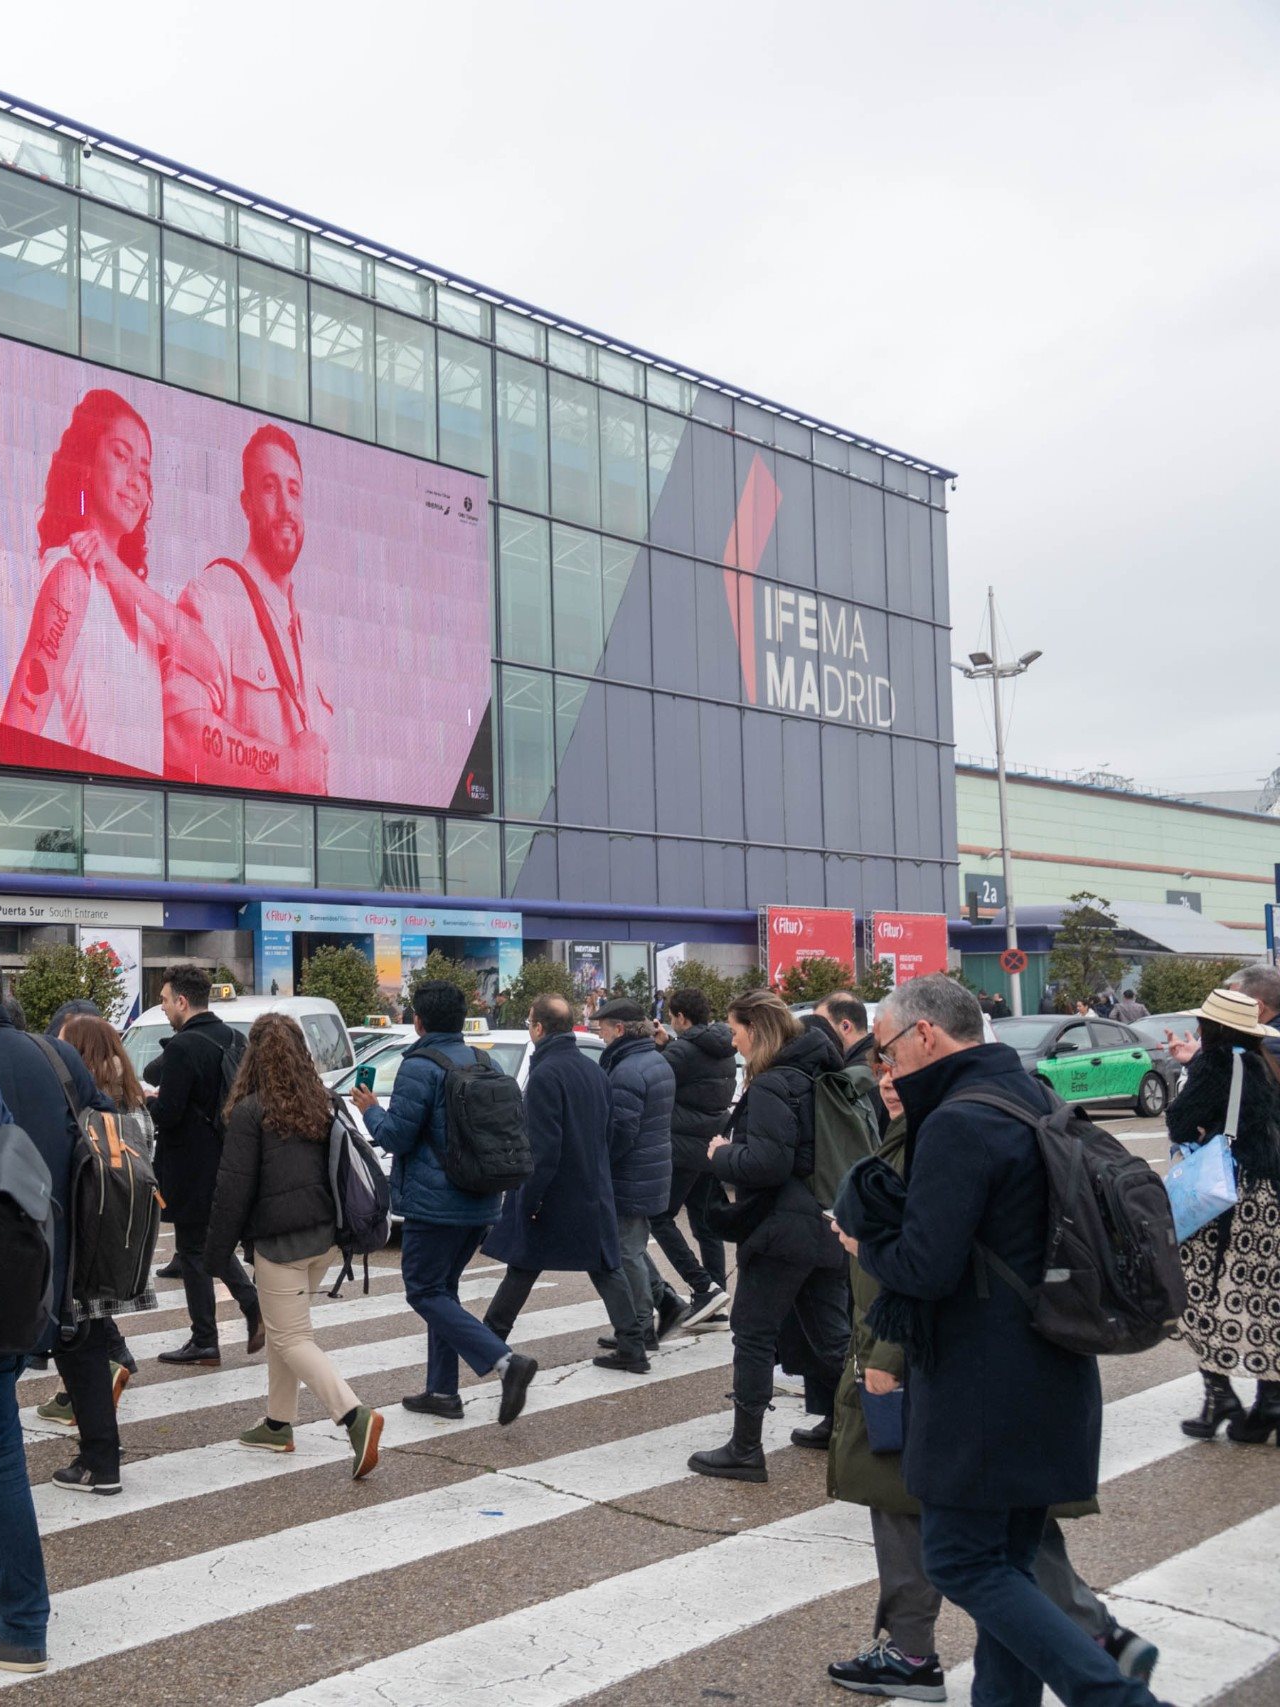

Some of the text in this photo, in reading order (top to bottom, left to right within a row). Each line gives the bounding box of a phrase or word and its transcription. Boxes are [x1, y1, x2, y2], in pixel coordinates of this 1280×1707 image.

[764, 586, 868, 663] IFEMA
[766, 651, 896, 728] MADRID
[202, 725, 279, 775] GO TOURISM
[983, 881, 997, 903] 2a
[30, 906, 44, 917] Sur
[49, 907, 72, 919] South
[75, 908, 109, 920] Entrance
[778, 917, 798, 934] Fitur
[883, 922, 899, 938] Fitur
[1071, 1070, 1088, 1080] Uber
[1071, 1082, 1088, 1092] Eats
